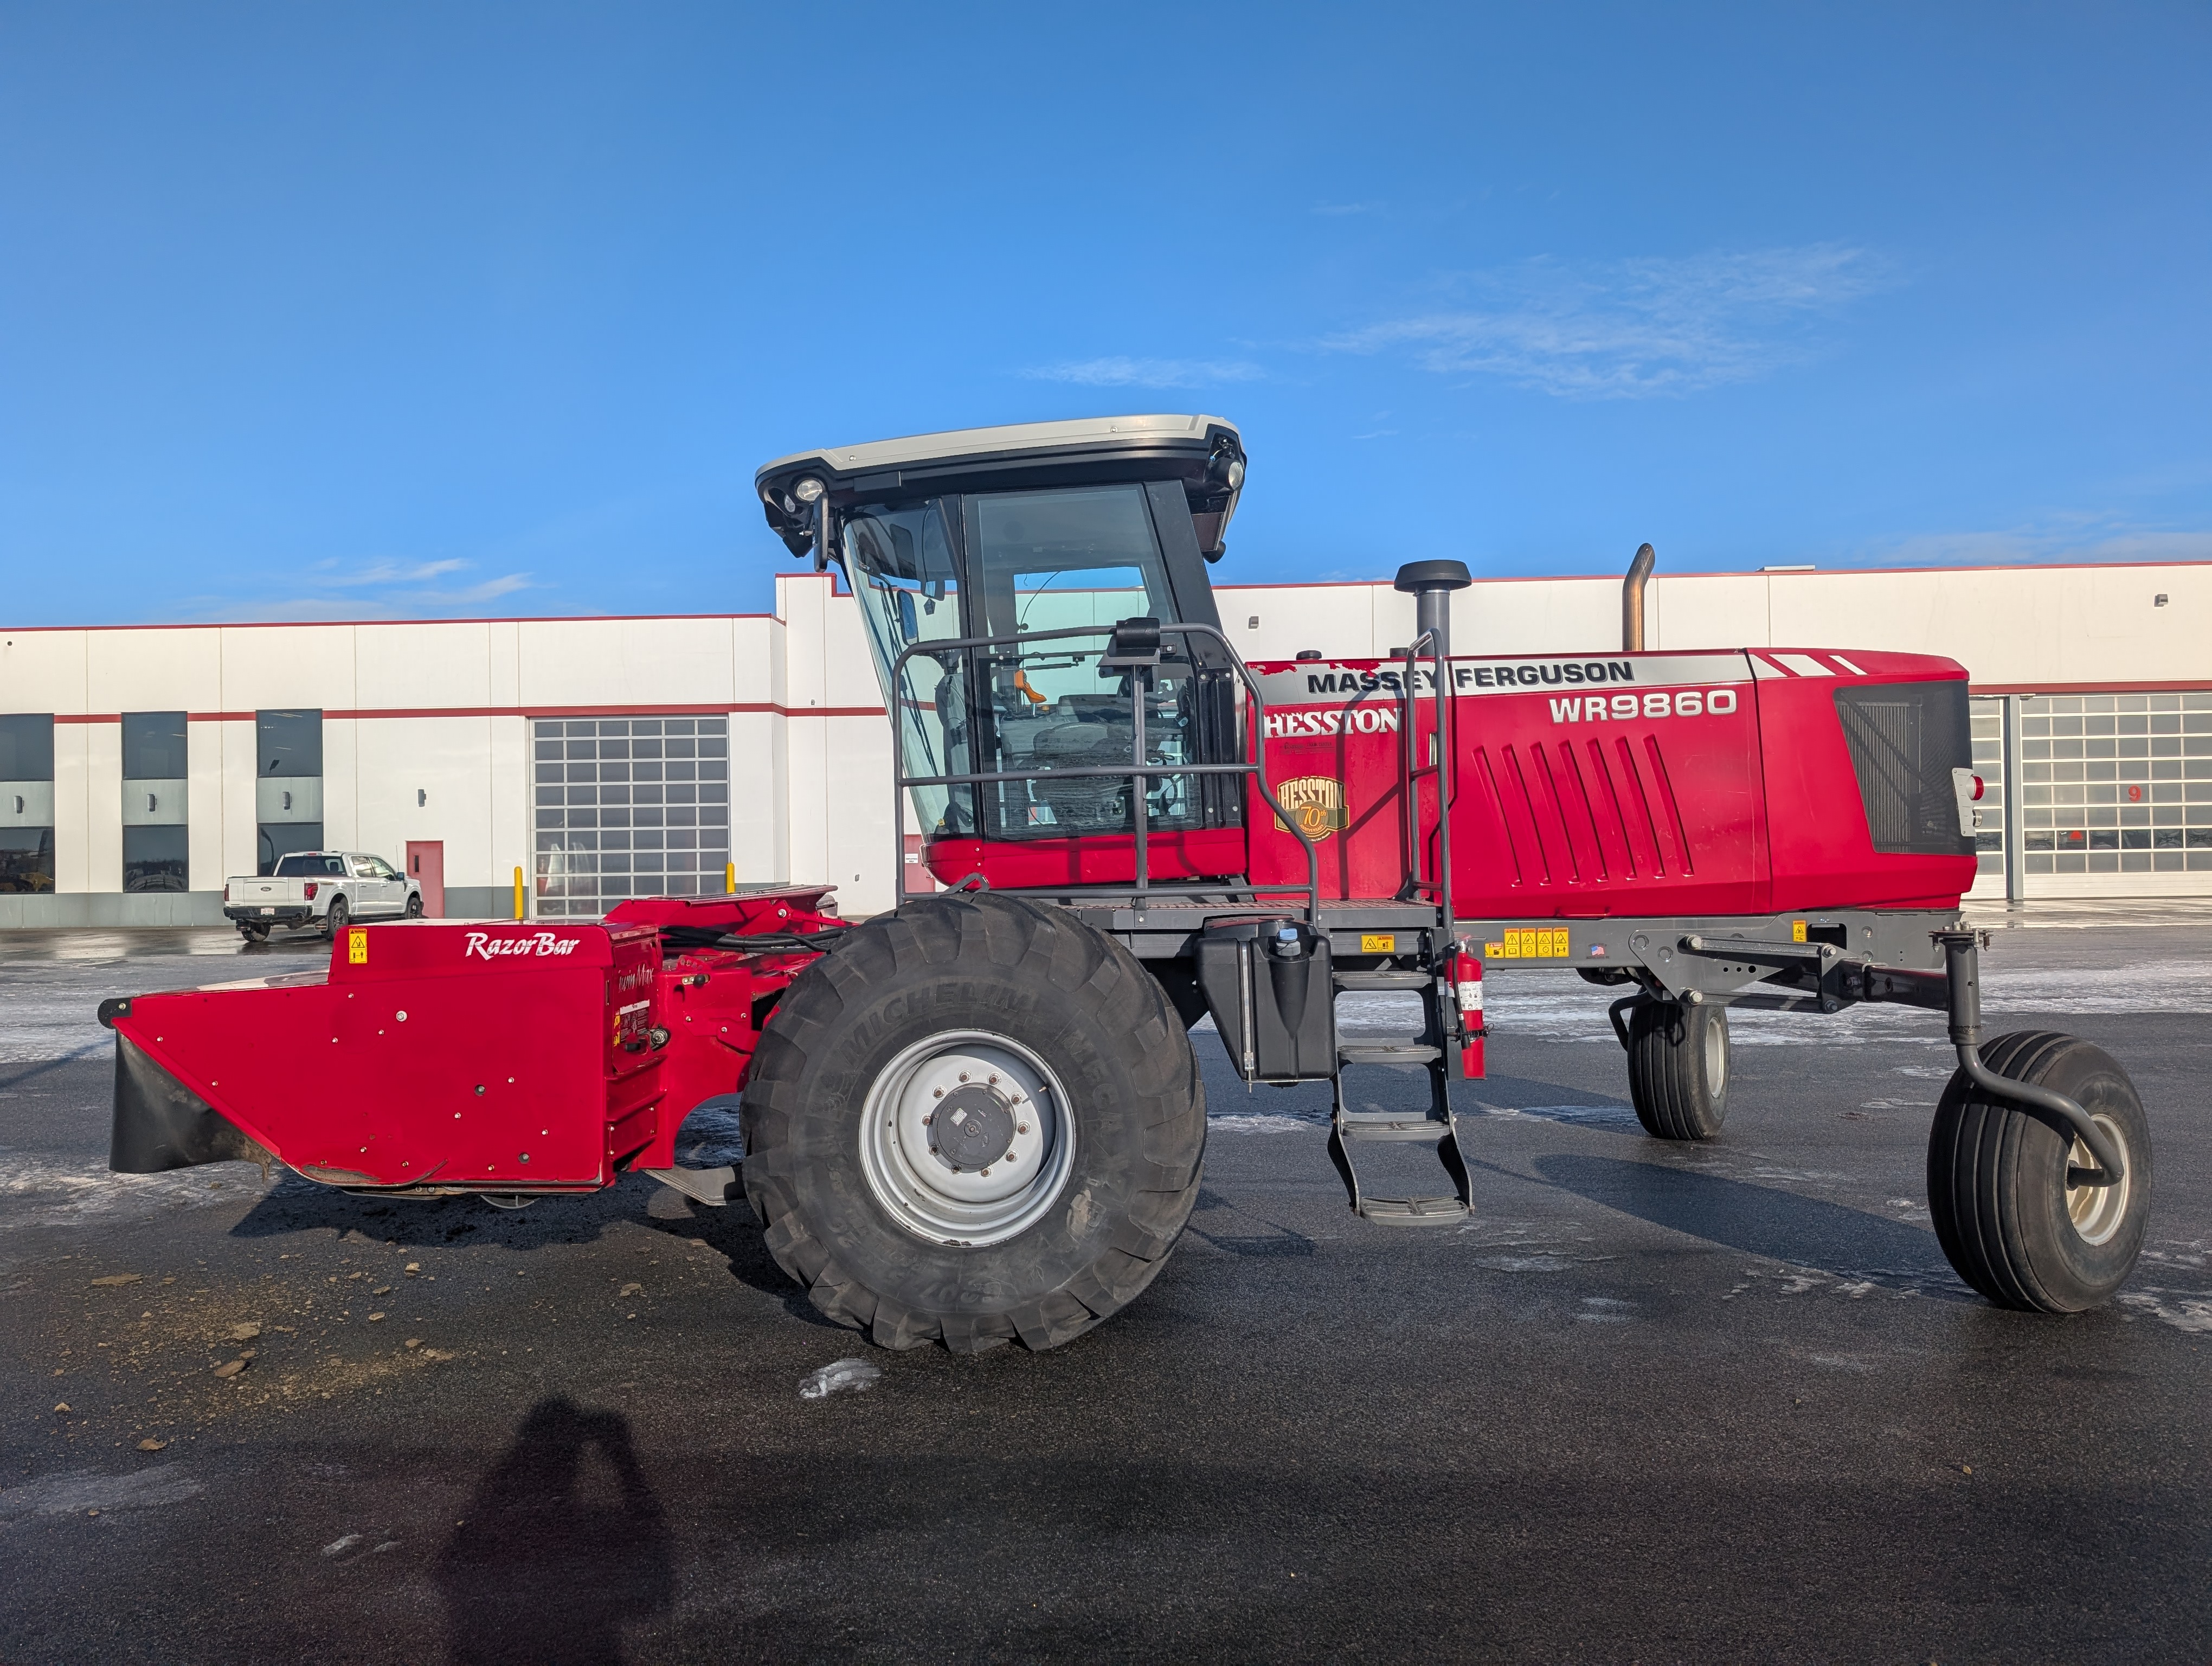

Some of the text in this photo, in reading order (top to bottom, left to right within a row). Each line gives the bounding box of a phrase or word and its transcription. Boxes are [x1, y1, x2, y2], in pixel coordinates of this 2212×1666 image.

[1307, 661, 1635, 694] MASSEY FERGUSON
[1548, 690, 1737, 723] WR9860
[1264, 707, 1403, 738] HESSTON
[1280, 778, 1343, 810] HESSTON
[2128, 785, 2141, 802] 9
[1299, 824, 1324, 832] ANNIVERSARY
[1301, 806, 1327, 826] 70th
[464, 932, 581, 961] RazorBar
[839, 982, 1032, 1069] MICHELIN
